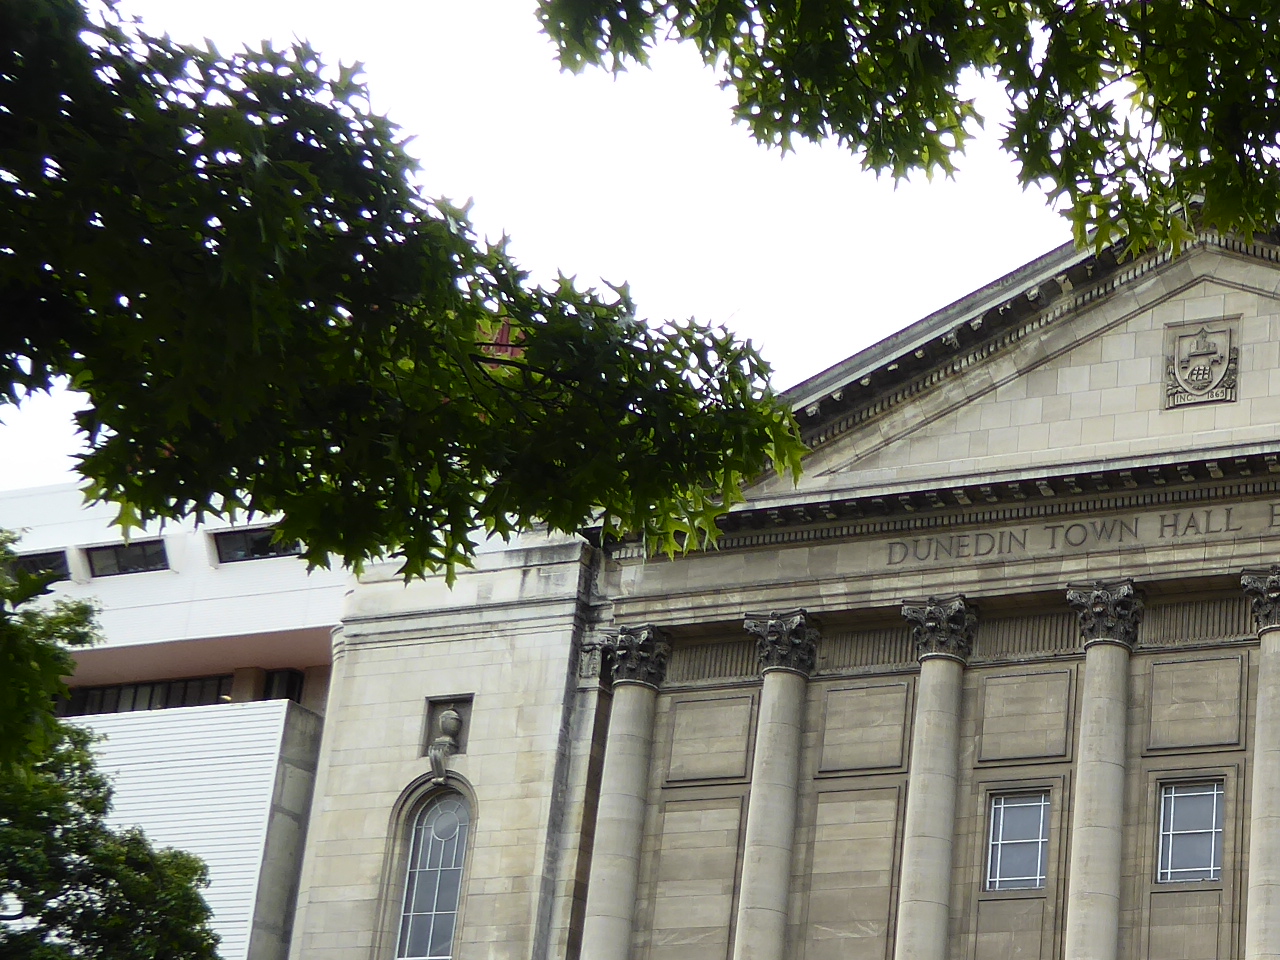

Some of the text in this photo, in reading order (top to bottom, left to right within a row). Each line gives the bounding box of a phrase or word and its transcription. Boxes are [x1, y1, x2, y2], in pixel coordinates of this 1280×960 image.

[1207, 389, 1225, 400] 1865
[887, 528, 1029, 566] DUNEDIN
[1044, 516, 1140, 550] TOWN
[1158, 507, 1243, 539] HALL
